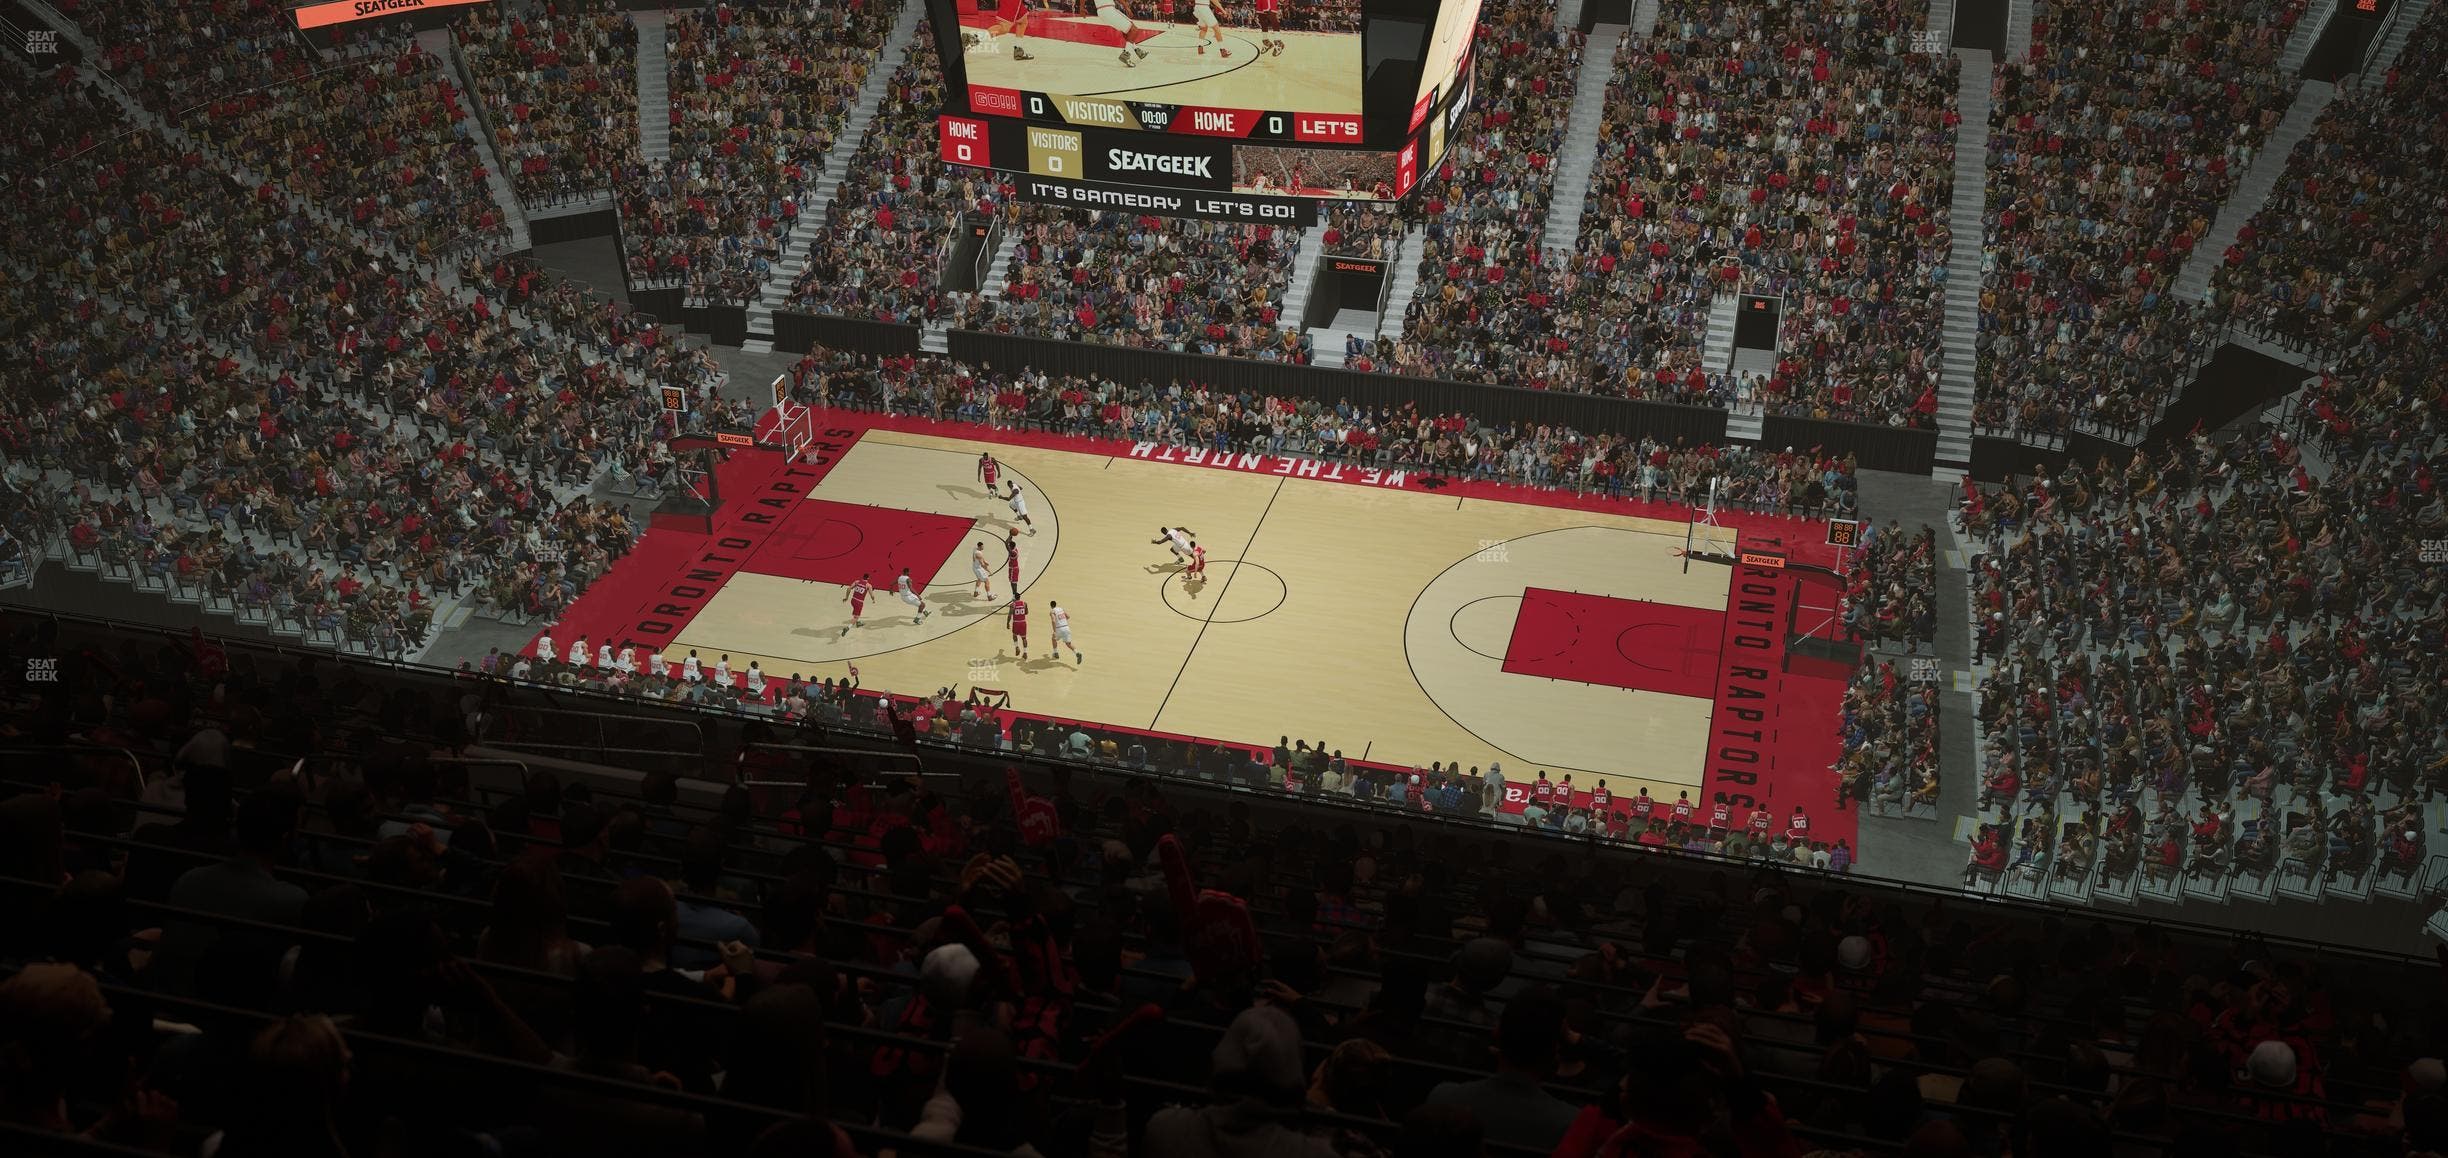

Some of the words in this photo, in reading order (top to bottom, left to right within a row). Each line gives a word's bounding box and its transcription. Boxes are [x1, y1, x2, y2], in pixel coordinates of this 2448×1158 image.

[1030, 97, 1043, 114] 0
[1065, 100, 1125, 124] VISITORS
[1141, 111, 1167, 125] 00:00
[1194, 111, 1235, 133] HOME
[1269, 116, 1283, 134] 0
[949, 121, 978, 140] HOME
[1302, 119, 1359, 136] LET'S
[1031, 131, 1078, 152] VISITORS
[957, 144, 971, 161] 0
[1048, 156, 1063, 172] 0
[1108, 148, 1212, 179] SEATGEEK
[1032, 183, 1068, 199] IT'S
[1073, 188, 1182, 210] GAMEDAY
[1195, 201, 1254, 216] LET'S
[1259, 204, 1296, 219] GO!
[1335, 262, 1377, 273] SEATGEEK
[1272, 455, 1344, 480] THE
[1746, 555, 1780, 566] SEATGEEK
[1538, 787, 1550, 795] 00
[1556, 786, 1568, 796] 00
[1676, 806, 1688, 815] 00
[1715, 812, 1727, 820] 00
[1793, 820, 1807, 828] 00
